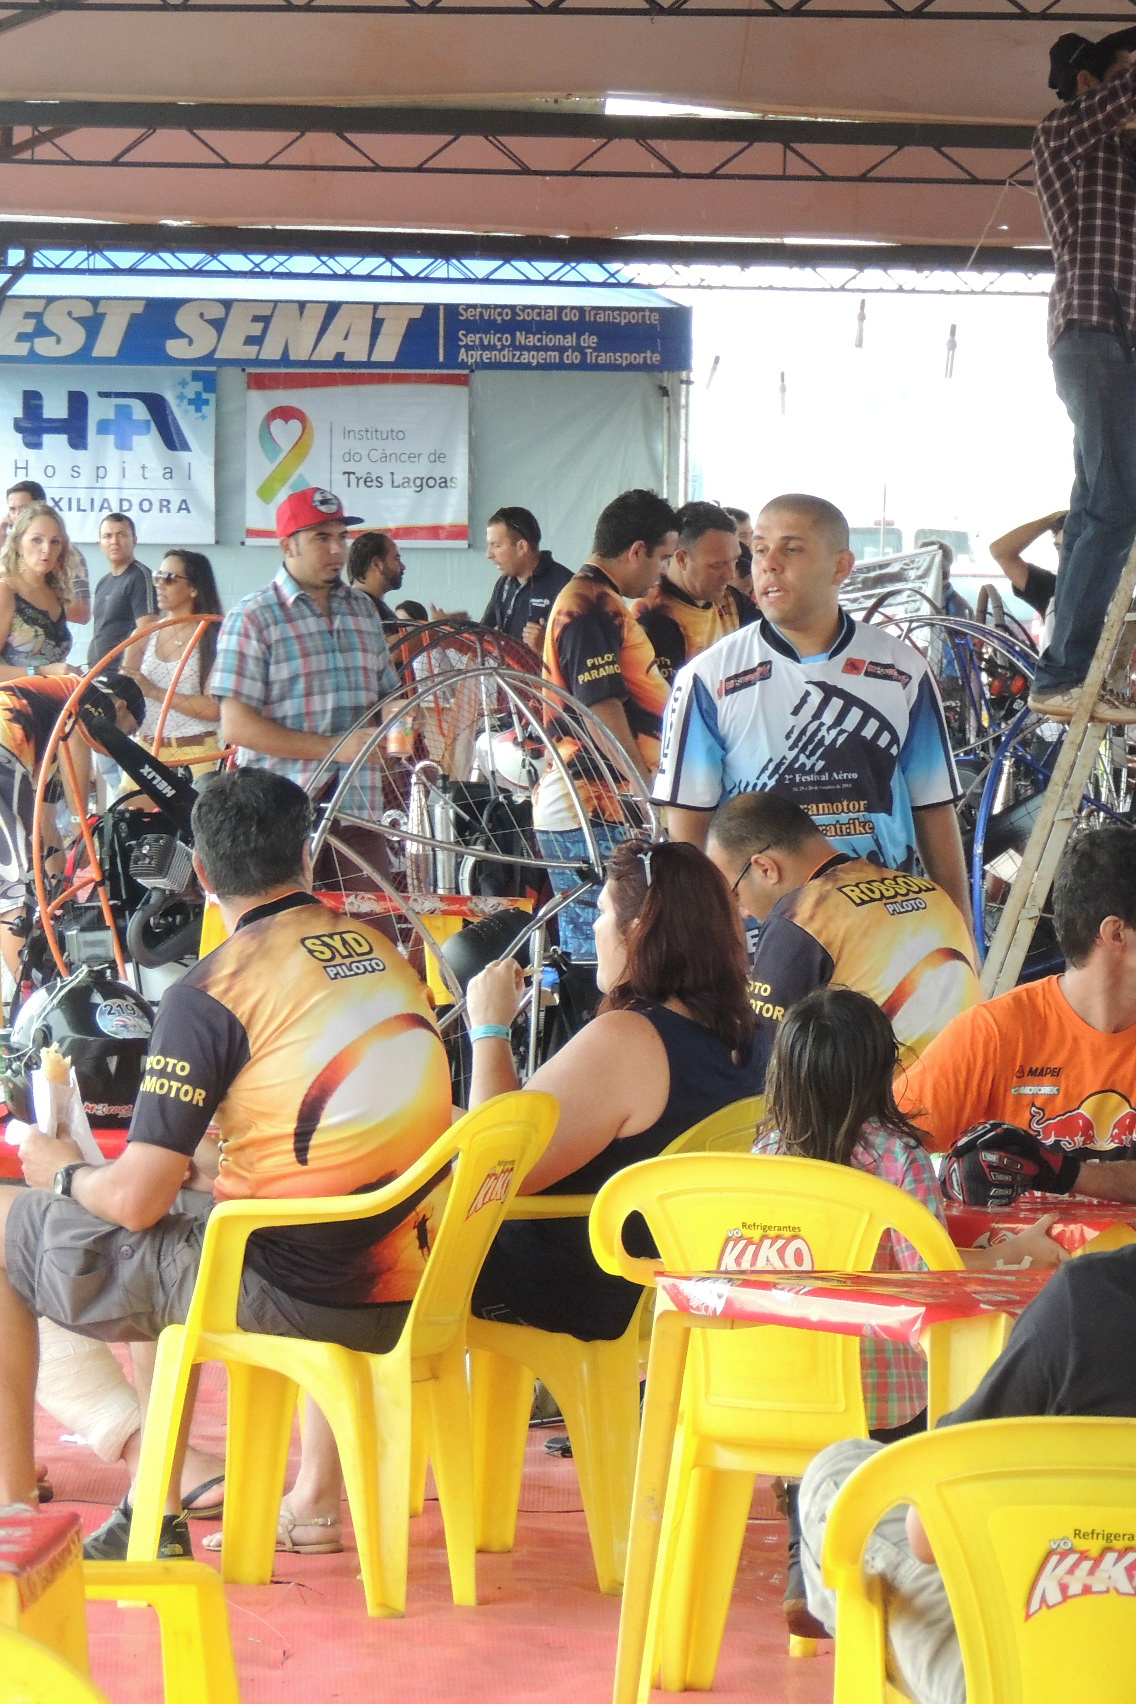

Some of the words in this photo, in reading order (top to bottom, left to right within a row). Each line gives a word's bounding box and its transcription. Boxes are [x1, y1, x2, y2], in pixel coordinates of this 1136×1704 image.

[458, 305, 512, 323] Serviço
[515, 305, 558, 321] Social
[562, 306, 579, 321] do
[584, 306, 660, 325] Transporte
[165, 301, 424, 362] SENAT
[458, 330, 512, 349] Serviço
[515, 331, 577, 346] Nacional
[580, 332, 598, 347] de
[457, 348, 560, 365] Aprendizagem
[563, 349, 581, 363] do
[585, 349, 661, 366] Transporte
[342, 427, 406, 441] Instituto
[342, 449, 362, 463] do
[367, 448, 423, 463] Câncer
[427, 449, 447, 464] de
[14, 459, 192, 483] Hospital
[342, 471, 384, 489] Três
[389, 472, 458, 493] Lagoas
[50, 496, 192, 514] XILIADORA
[577, 664, 621, 684] PARAMO
[139, 764, 177, 798] HELIX
[795, 772, 829, 783] Festival
[832, 770, 858, 781] Aéreo
[799, 800, 868, 816] ramotor
[818, 819, 875, 836] ratrike
[839, 875, 936, 906] ROBSON
[885, 898, 927, 915] PILOTO
[302, 931, 374, 962] SYD
[322, 957, 387, 980] PILOTO
[746, 980, 772, 997] OTO
[104, 1003, 138, 1017] 219
[750, 999, 785, 1021] TOR
[145, 1055, 190, 1076] OTO
[1026, 1066, 1062, 1078] MAPEI
[140, 1075, 206, 1107] MOTOR
[1020, 1086, 1060, 1095] MOTOREX
[741, 1221, 802, 1234] Refrigerantes
